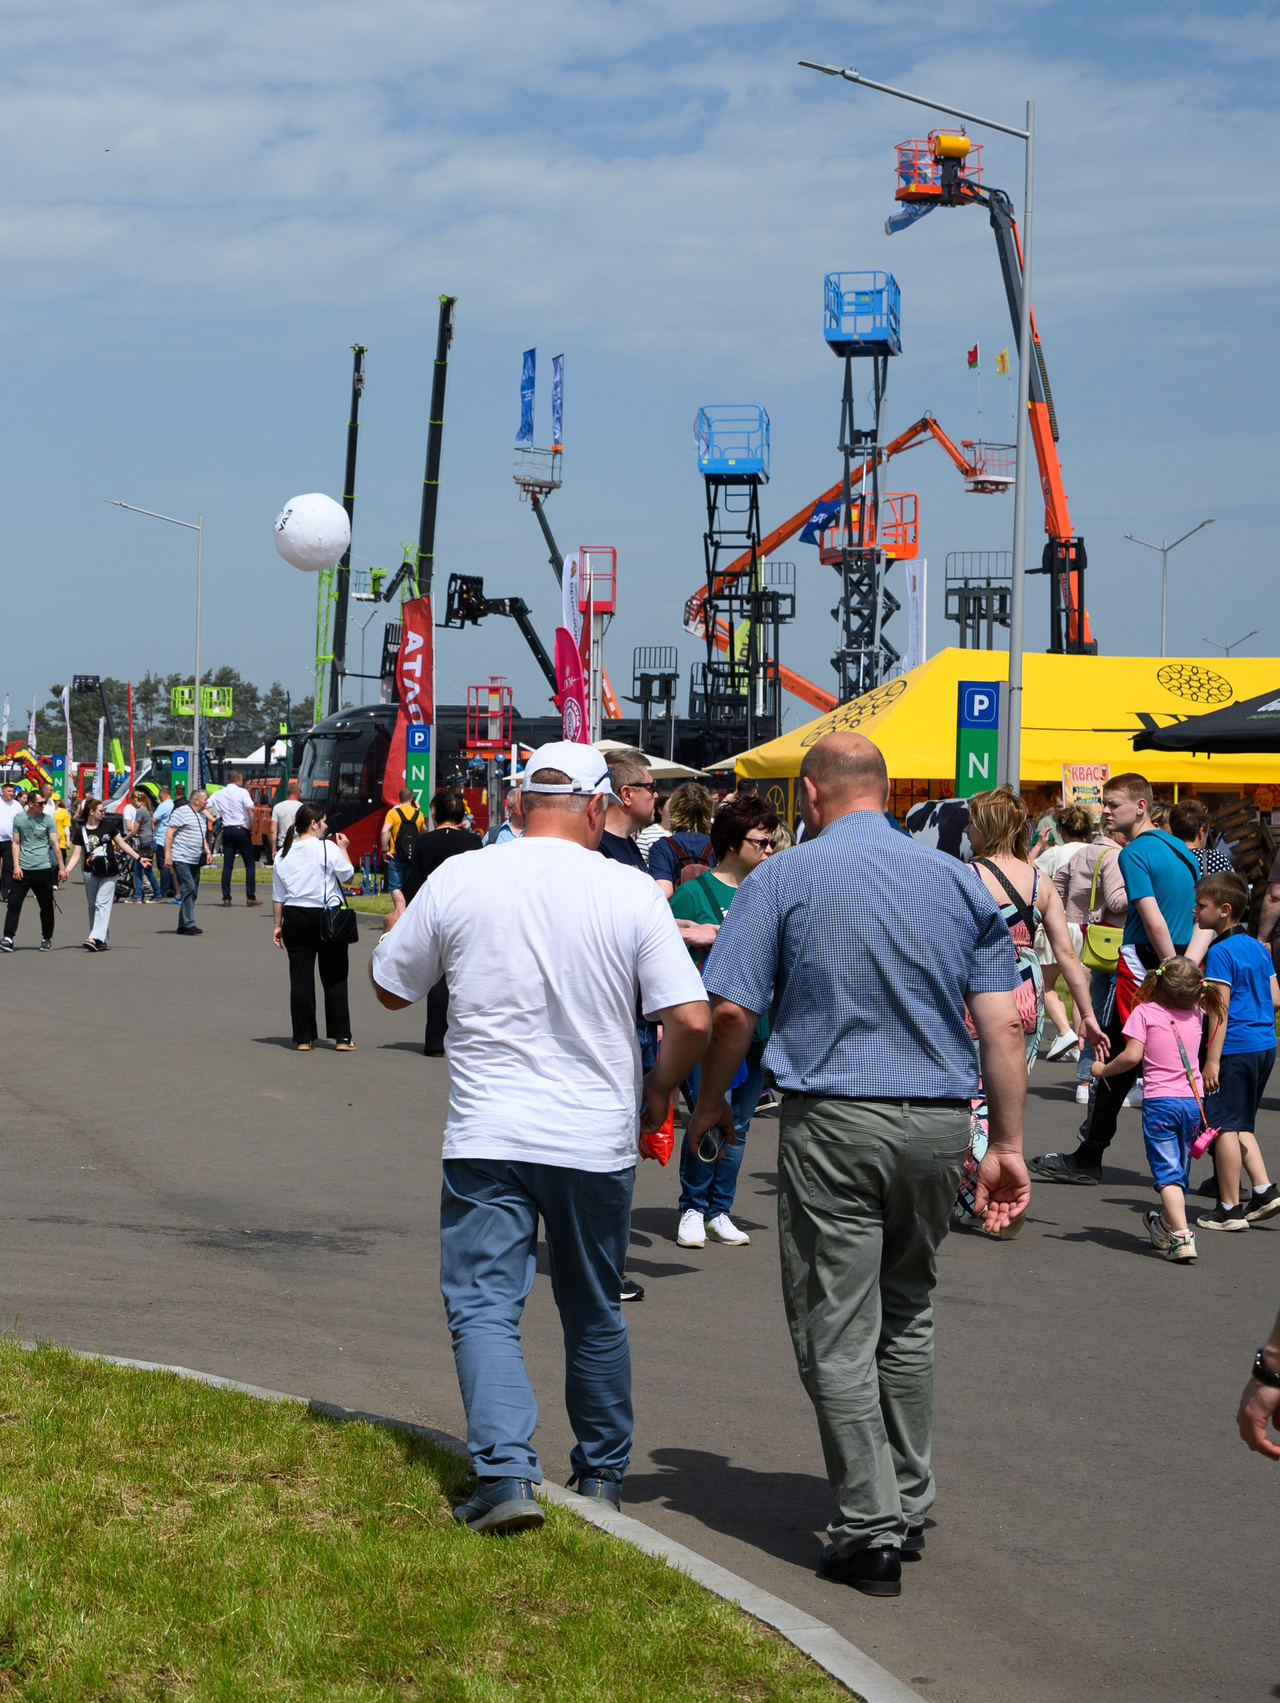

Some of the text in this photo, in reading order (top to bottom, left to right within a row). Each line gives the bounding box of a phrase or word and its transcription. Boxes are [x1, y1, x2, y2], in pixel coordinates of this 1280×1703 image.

[973, 694, 990, 716] P
[414, 732, 425, 746] P
[56, 759, 63, 767] P
[176, 756, 185, 767] P
[968, 752, 989, 779] N
[411, 764, 425, 781] N
[1071, 766, 1100, 781] КВАС
[54, 777, 63, 787] N
